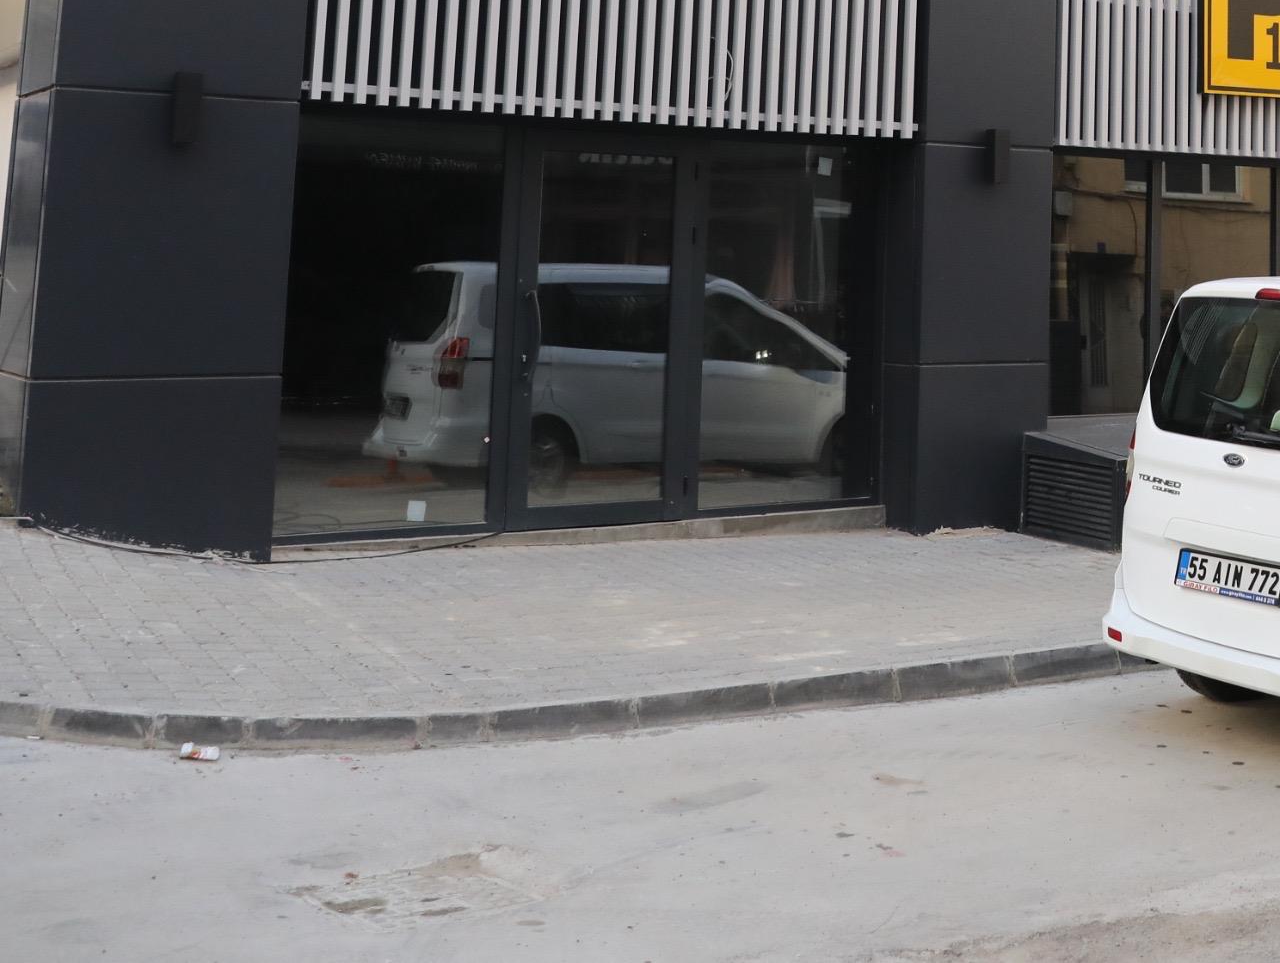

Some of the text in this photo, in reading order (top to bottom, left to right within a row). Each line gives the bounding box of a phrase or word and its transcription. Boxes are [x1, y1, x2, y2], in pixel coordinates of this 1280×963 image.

[1138, 473, 1182, 489] TOURNEO
[1152, 485, 1181, 496] COURIER
[1188, 556, 1280, 596] 55 AIN 772
